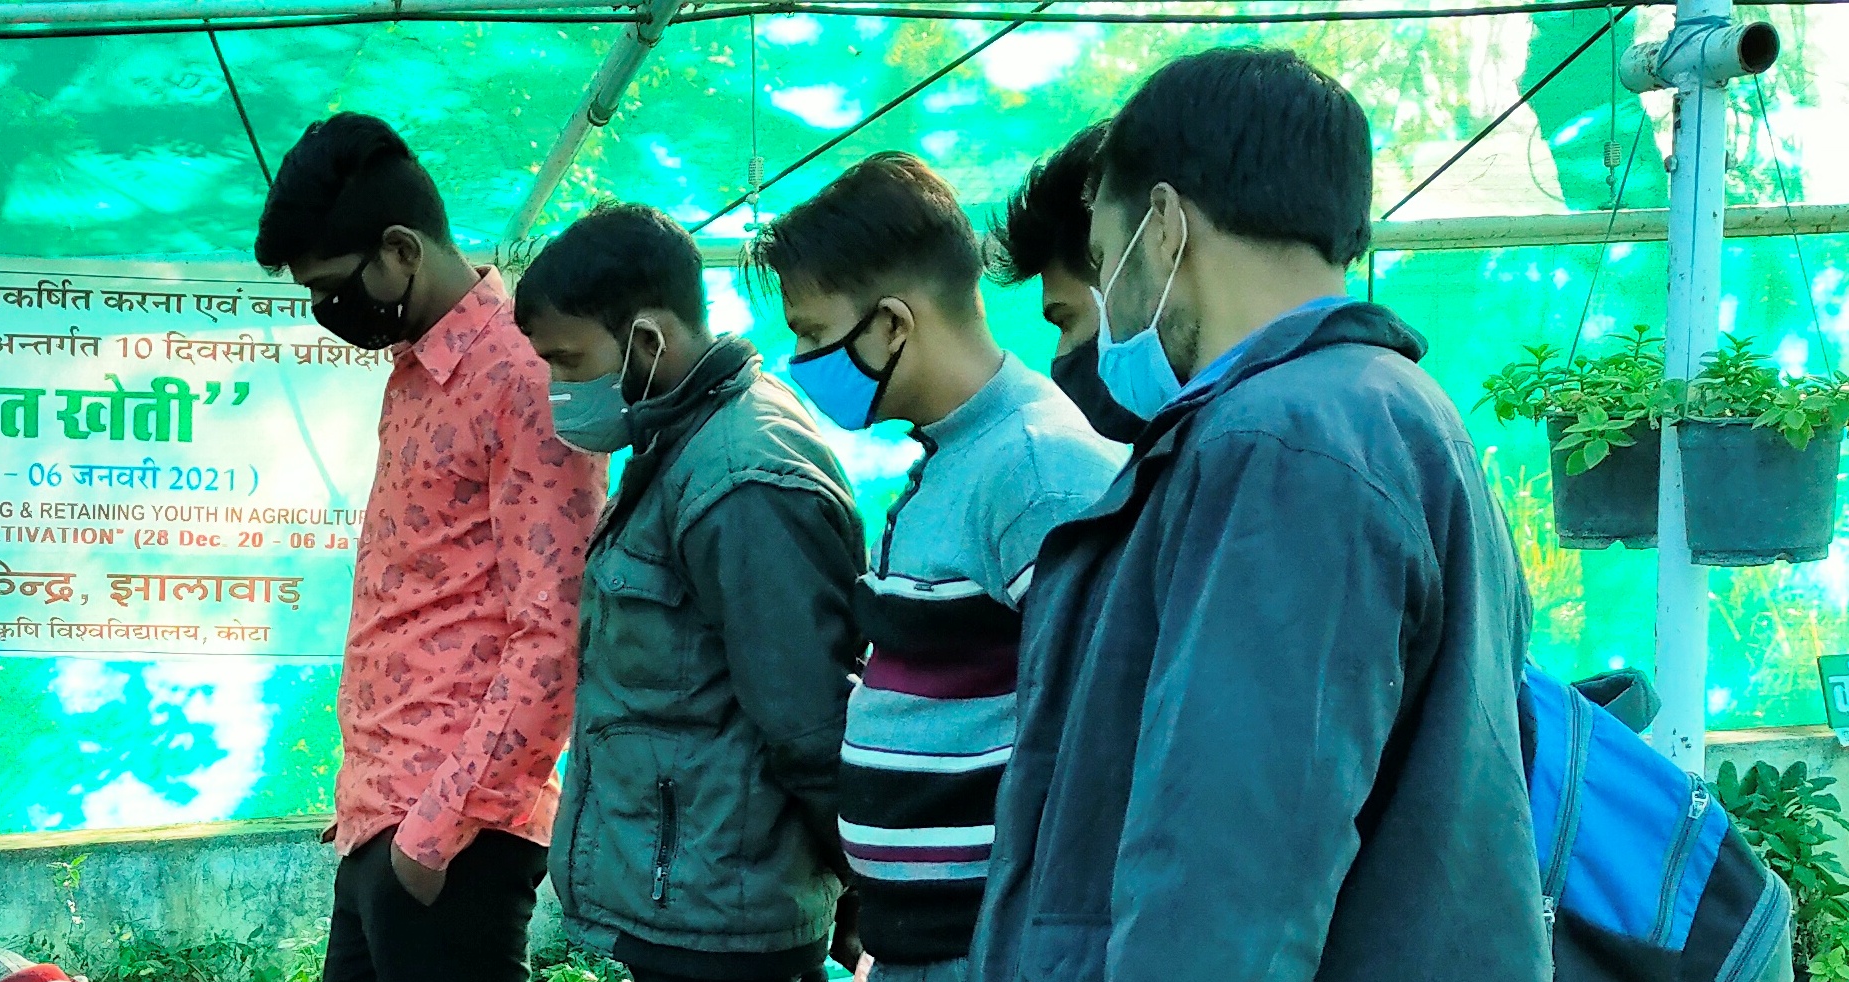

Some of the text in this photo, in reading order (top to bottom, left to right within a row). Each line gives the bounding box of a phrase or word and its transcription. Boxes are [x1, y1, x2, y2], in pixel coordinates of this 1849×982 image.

[101, 289, 186, 314] करना
[192, 287, 244, 322] एवं
[249, 296, 312, 319] बना
[116, 336, 153, 360] 10
[163, 331, 282, 367] दिवसीय
[27, 461, 63, 488] 06
[70, 457, 161, 491] जनवरी
[169, 467, 236, 493] 2021
[19, 503, 33, 520] &
[40, 503, 145, 521] RETAINING
[150, 505, 219, 523] YOUTH
[224, 507, 243, 524] IN
[134, 529, 170, 551] (28
[238, 531, 264, 549] 20
[290, 532, 316, 549] 06
[324, 533, 359, 550] Ja
[106, 573, 305, 611] झालावाड़
[214, 619, 272, 643] कोटा
